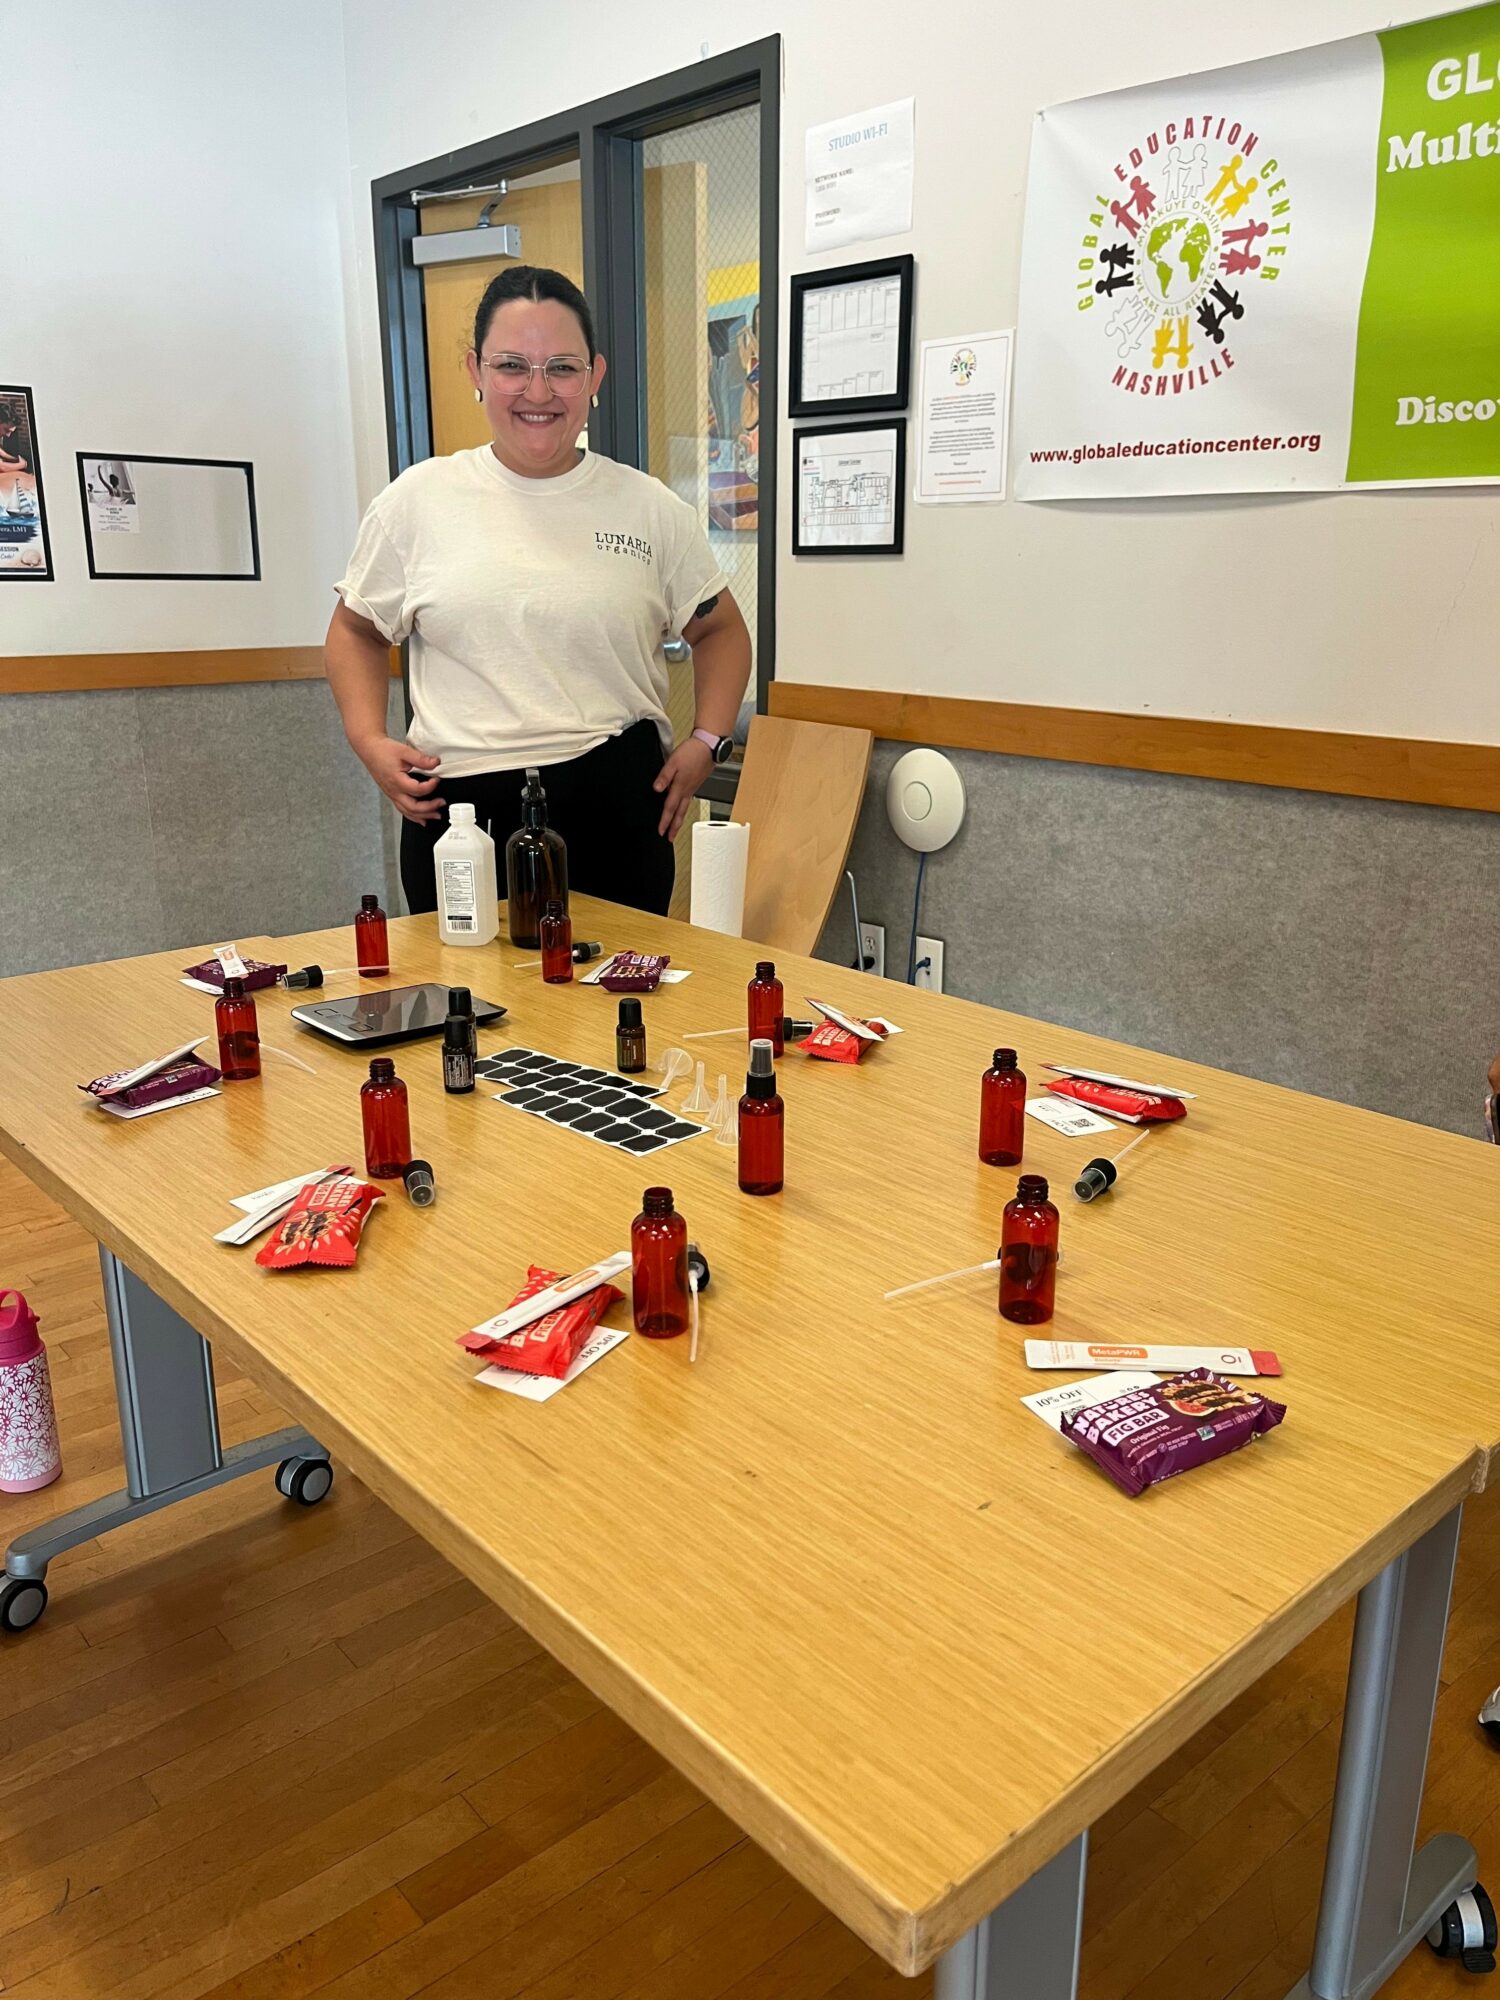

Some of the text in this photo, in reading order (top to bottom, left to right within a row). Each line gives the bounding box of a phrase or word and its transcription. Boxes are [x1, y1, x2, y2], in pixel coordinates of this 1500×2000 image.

[1427, 52, 1500, 101] GL
[828, 122, 888, 152] STUDIO WI-FI
[1077, 115, 1291, 312] GLOBAL EDUCATION CENTER
[1192, 201, 1221, 233] OYASIN
[1143, 296, 1159, 313] ARE
[1163, 307, 1181, 316] ALL
[1184, 262, 1217, 311] RELATED
[1111, 348, 1235, 396] NASHVILLE
[1395, 395, 1500, 426] Disco
[1030, 434, 1321, 465] www.globaleducationcenter.org
[595, 532, 652, 558] LUNARIA
[597, 544, 651, 565] organics
[1091, 1348, 1140, 1357] MetaPWR
[1036, 1396, 1060, 1407] 10%
[1086, 1396, 1159, 1445] BAKERY
[1108, 1411, 1163, 1440] FIG BAR
[1130, 1424, 1170, 1444] Original Fig
